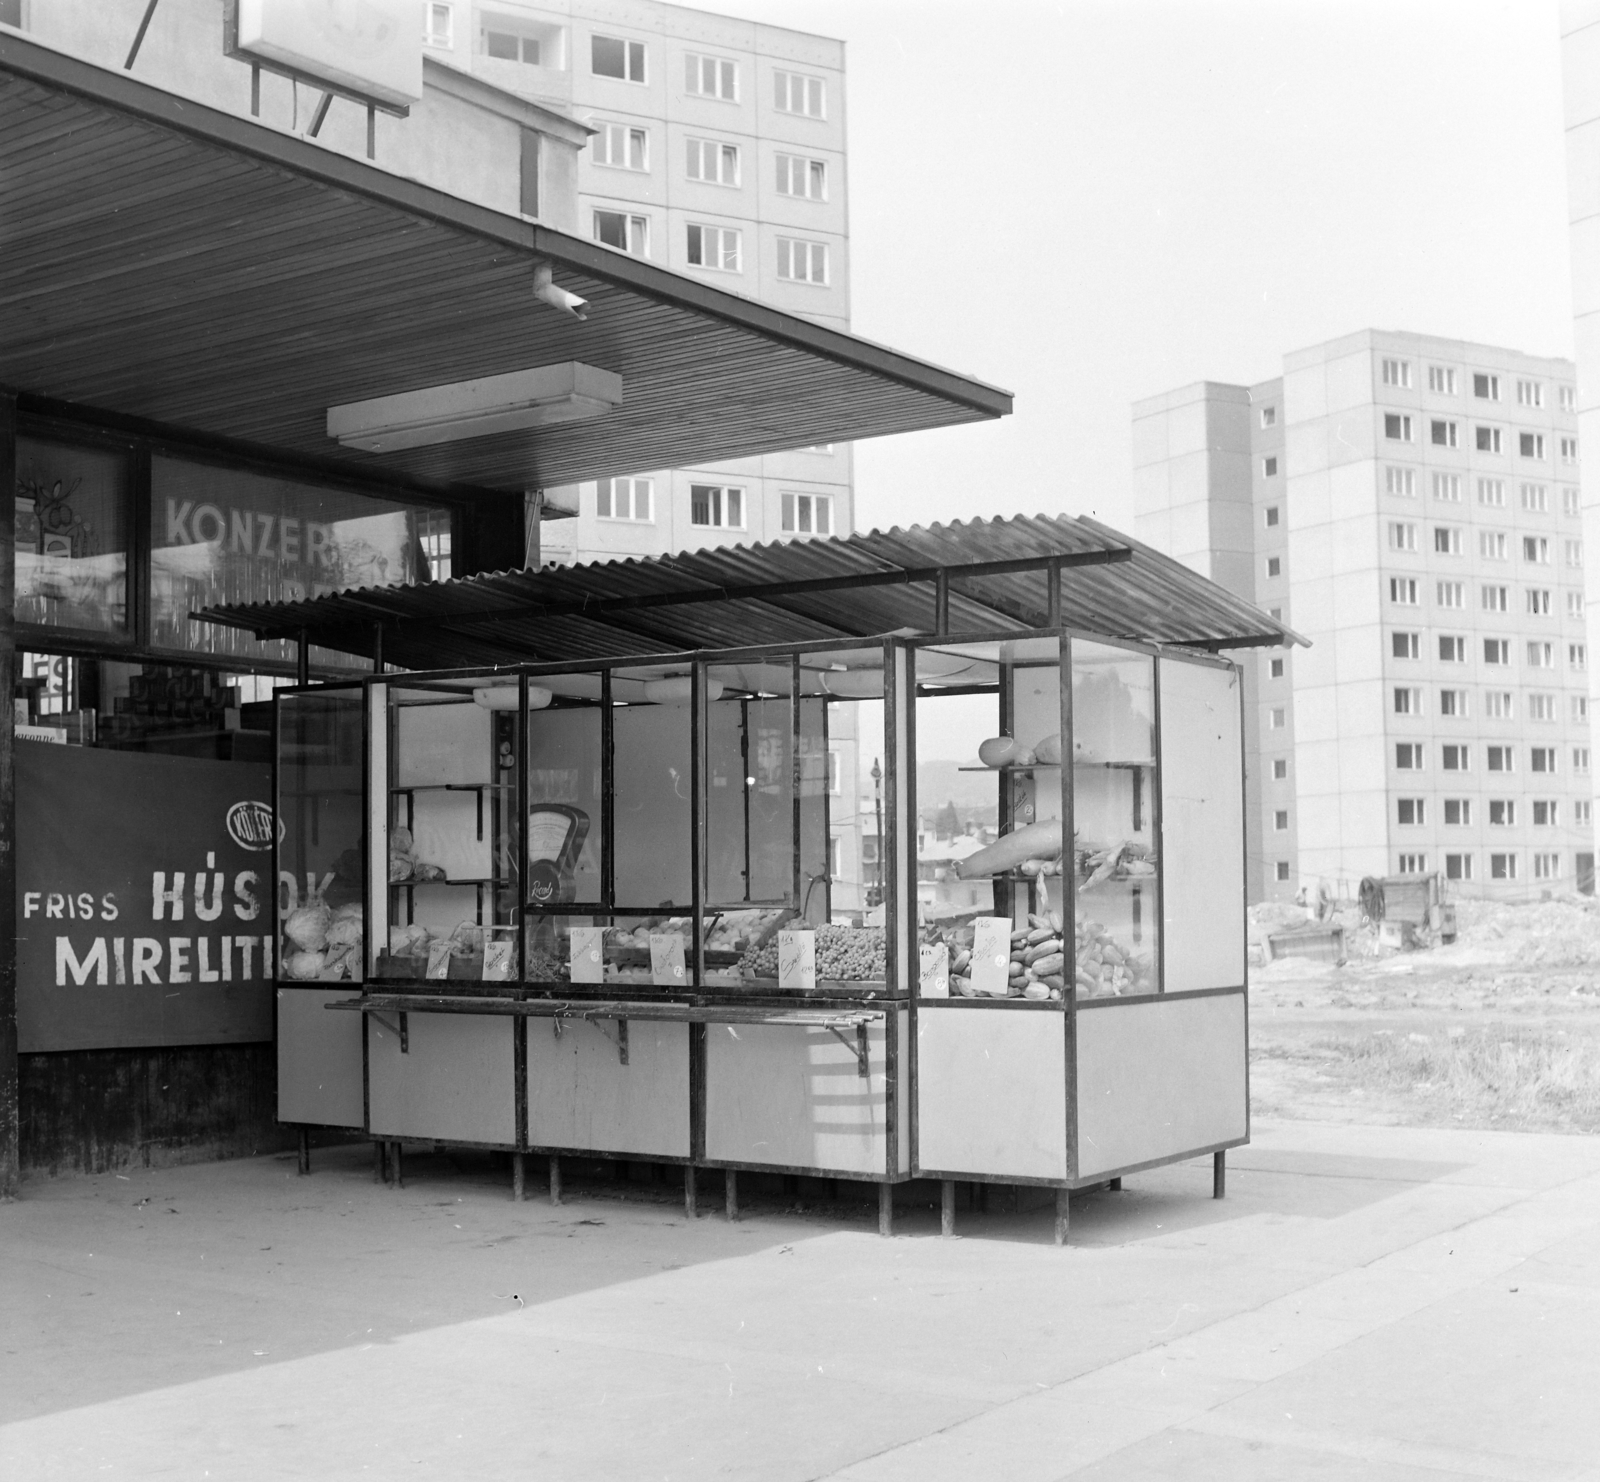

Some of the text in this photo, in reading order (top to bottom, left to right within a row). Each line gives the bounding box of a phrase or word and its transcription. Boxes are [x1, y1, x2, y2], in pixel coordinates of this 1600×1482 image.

[233, 806, 273, 842] KÖZÉR
[23, 851, 336, 921] FRISS HÚSOK
